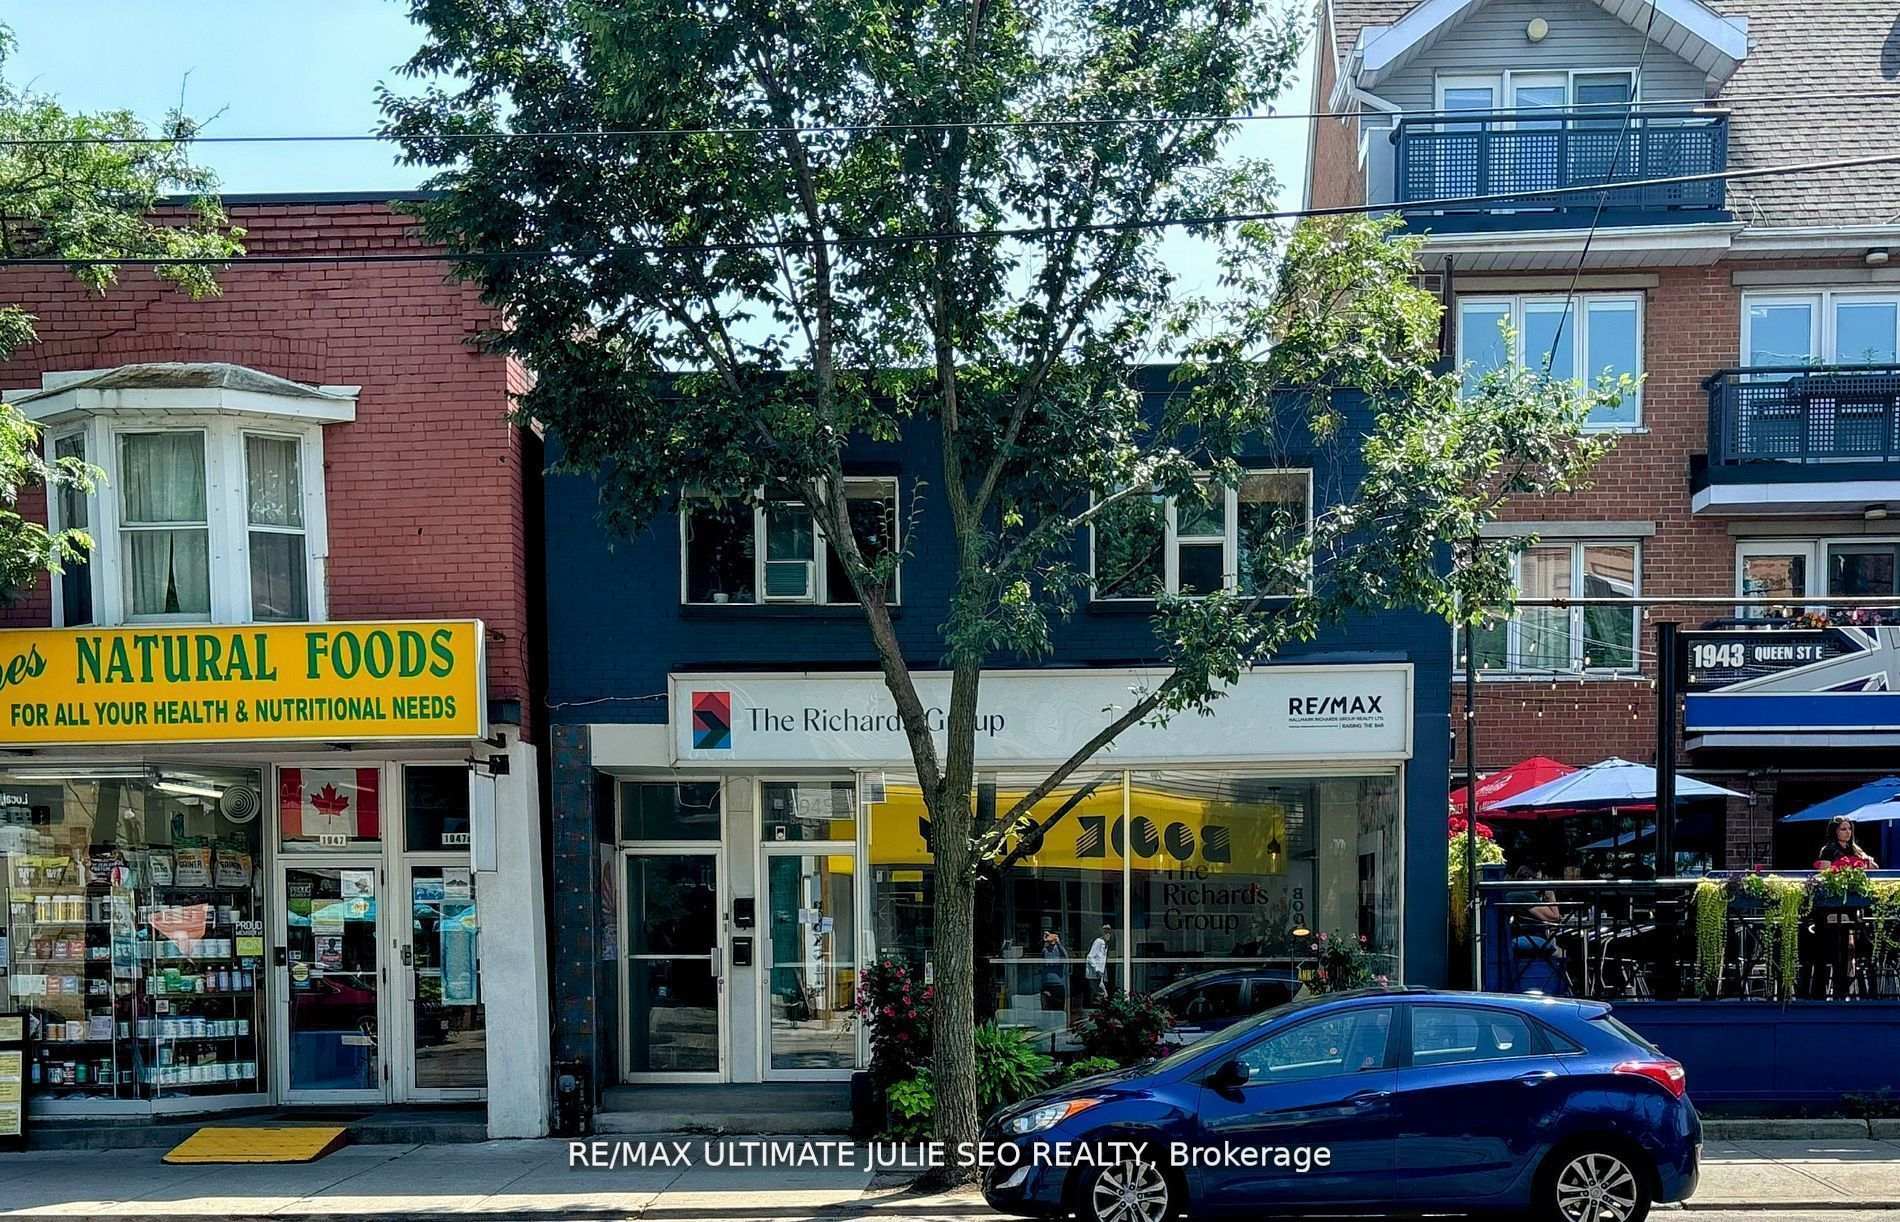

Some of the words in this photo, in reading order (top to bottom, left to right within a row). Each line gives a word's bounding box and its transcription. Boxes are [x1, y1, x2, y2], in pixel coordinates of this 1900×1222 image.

[75, 633, 277, 684] NATURAL
[305, 629, 455, 680] FOODS
[1692, 643, 1745, 668] 1943
[1754, 646, 1793, 662] QUEEN
[1796, 646, 1811, 660] ST
[1815, 646, 1823, 660] E
[11, 703, 49, 727] FOR
[55, 702, 89, 726] ALL
[95, 701, 148, 725] YOUR
[153, 700, 228, 724] HEALTH
[235, 699, 248, 723] &
[255, 697, 386, 722] NUTRITIONAL
[393, 695, 457, 720] NEEDS
[1288, 696, 1382, 716] RE/MAX
[745, 707, 794, 732] The
[804, 707, 905, 732] Richard
[925, 706, 1005, 737] Gup
[322, 836, 344, 845] 1947
[1162, 860, 1209, 881] The
[1164, 882, 1269, 905] Richards
[235, 920, 262, 930] PROUD
[1164, 909, 1239, 934] Group
